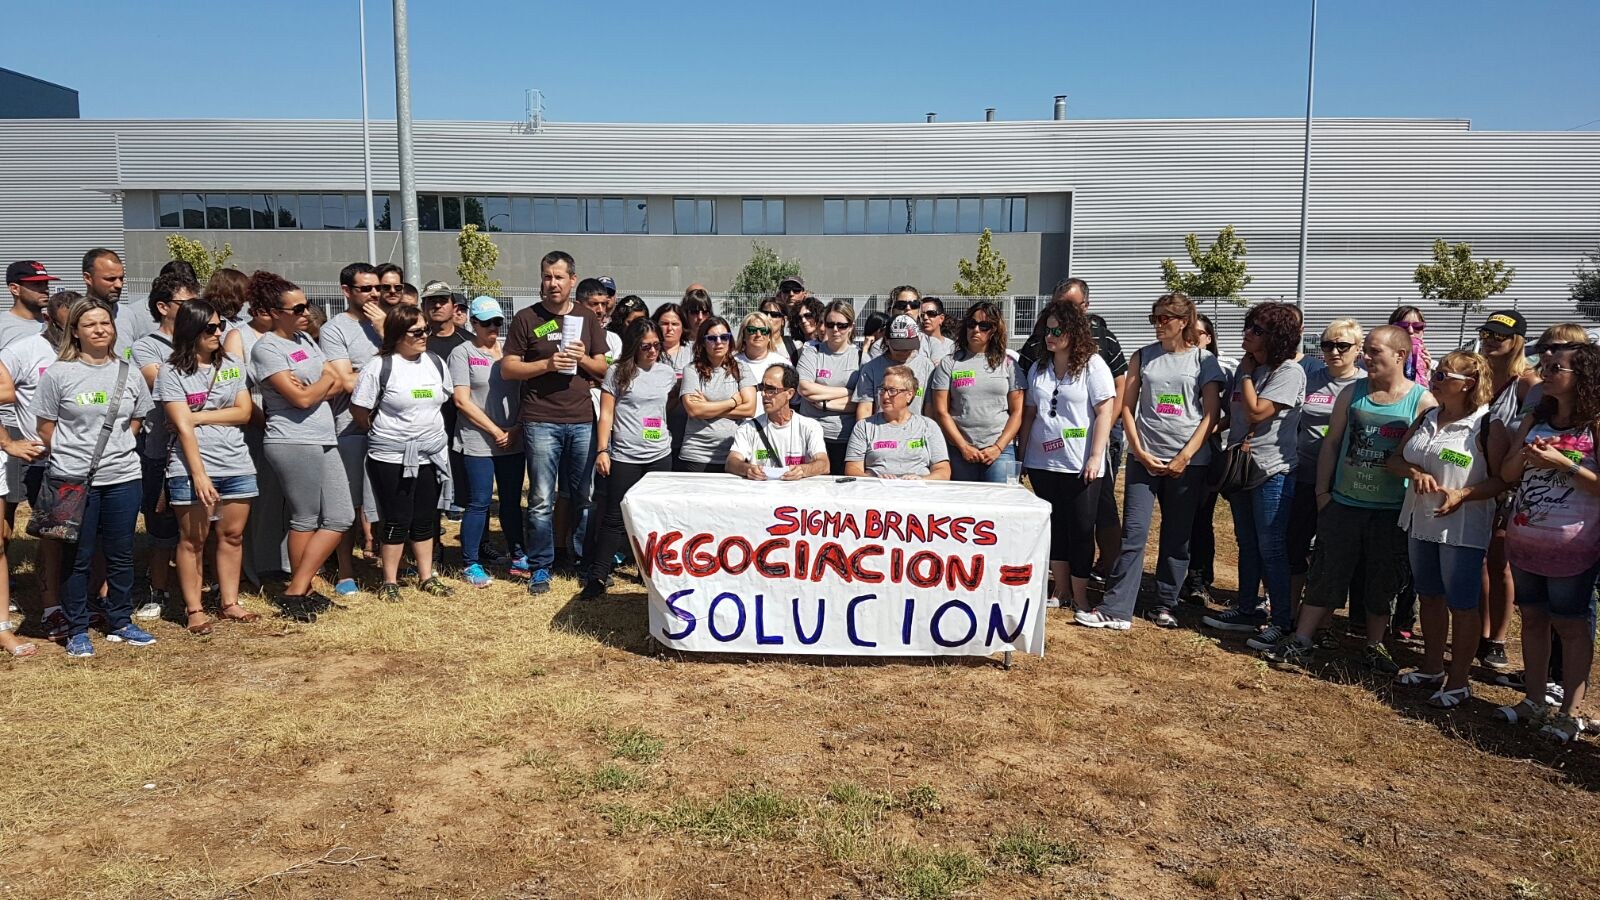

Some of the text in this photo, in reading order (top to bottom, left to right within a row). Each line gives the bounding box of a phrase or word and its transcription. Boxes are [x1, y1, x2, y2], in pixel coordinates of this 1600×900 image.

[1308, 396, 1330, 404] JUSTO
[1044, 441, 1064, 451] JUSTO
[1441, 453, 1468, 467] DIGNAS
[1357, 471, 1374, 481] THE
[1353, 481, 1380, 492] BEACH
[1521, 485, 1575, 507] Bad
[766, 506, 998, 546] SIGMA BRAKES
[661, 588, 1030, 648] SOLUCION
